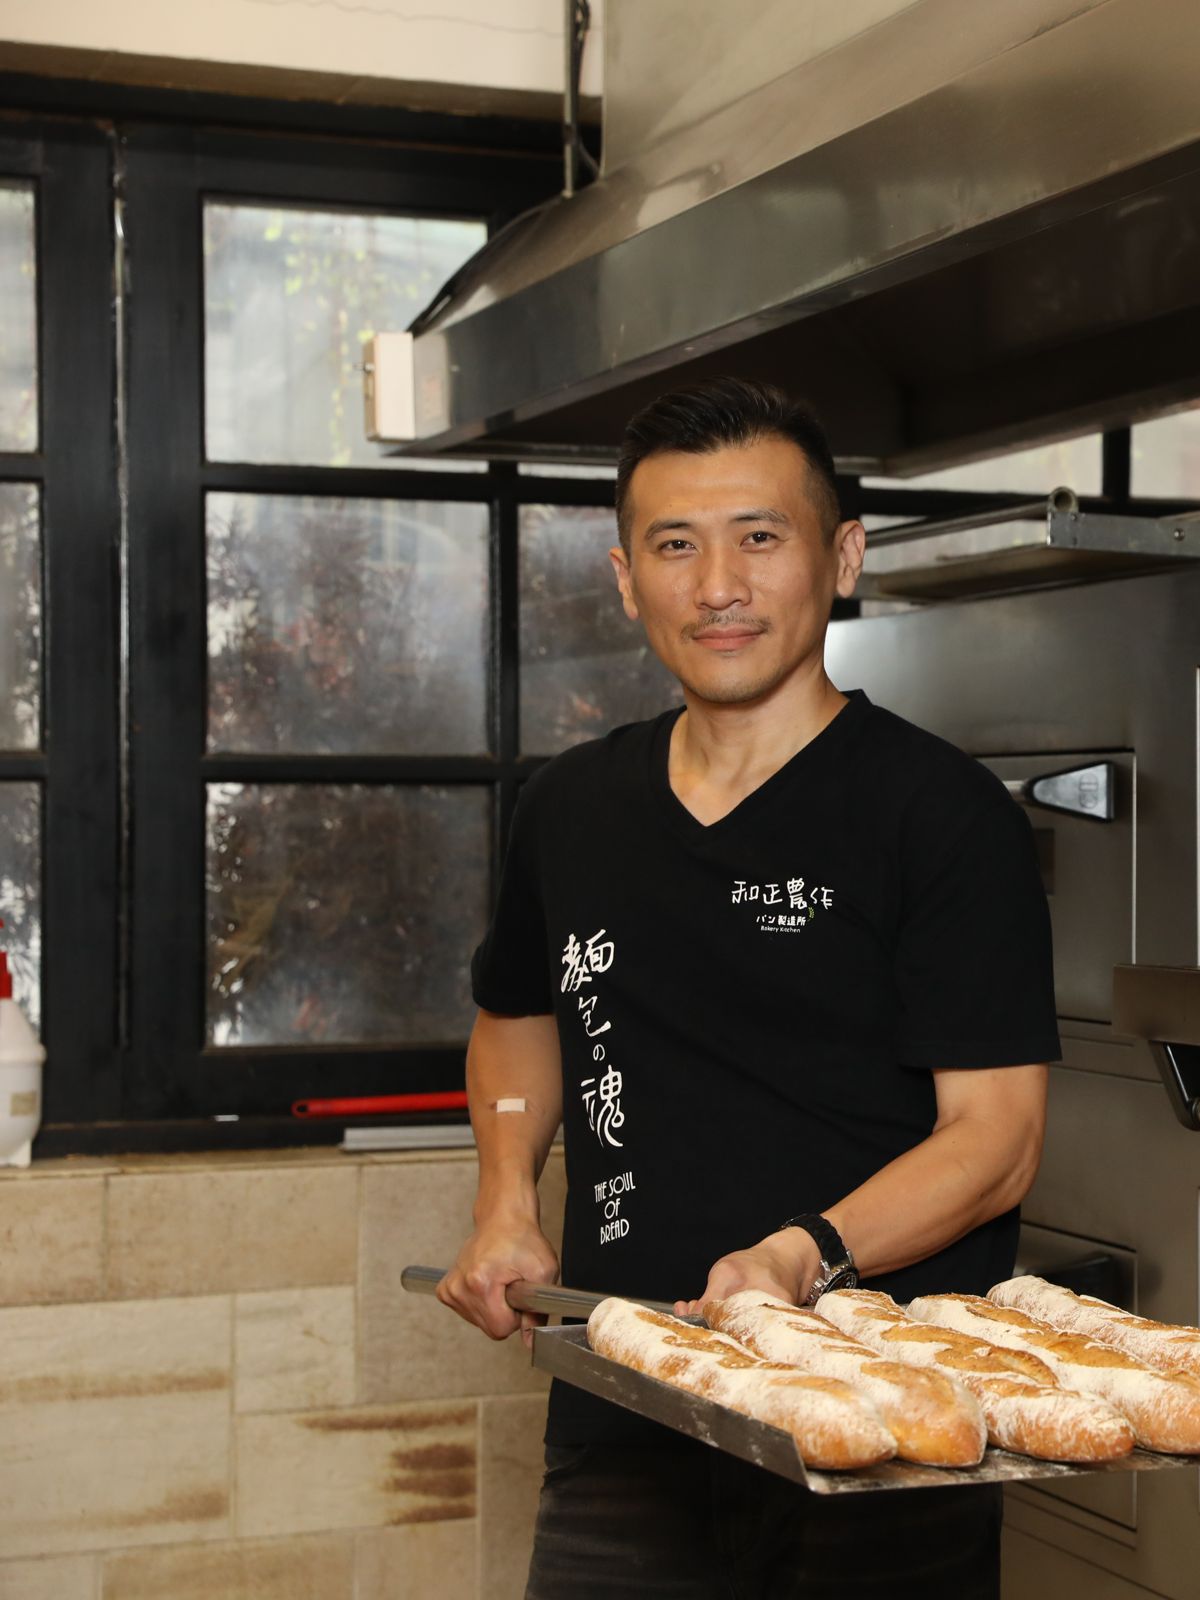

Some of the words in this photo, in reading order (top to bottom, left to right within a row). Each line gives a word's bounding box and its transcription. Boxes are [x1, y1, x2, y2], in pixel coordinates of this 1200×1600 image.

[731, 877, 835, 910] 和正農作
[594, 1180, 608, 1204] THE
[609, 1171, 637, 1197] SOUL
[604, 1197, 621, 1219] OF
[600, 1218, 630, 1246] BREAD
